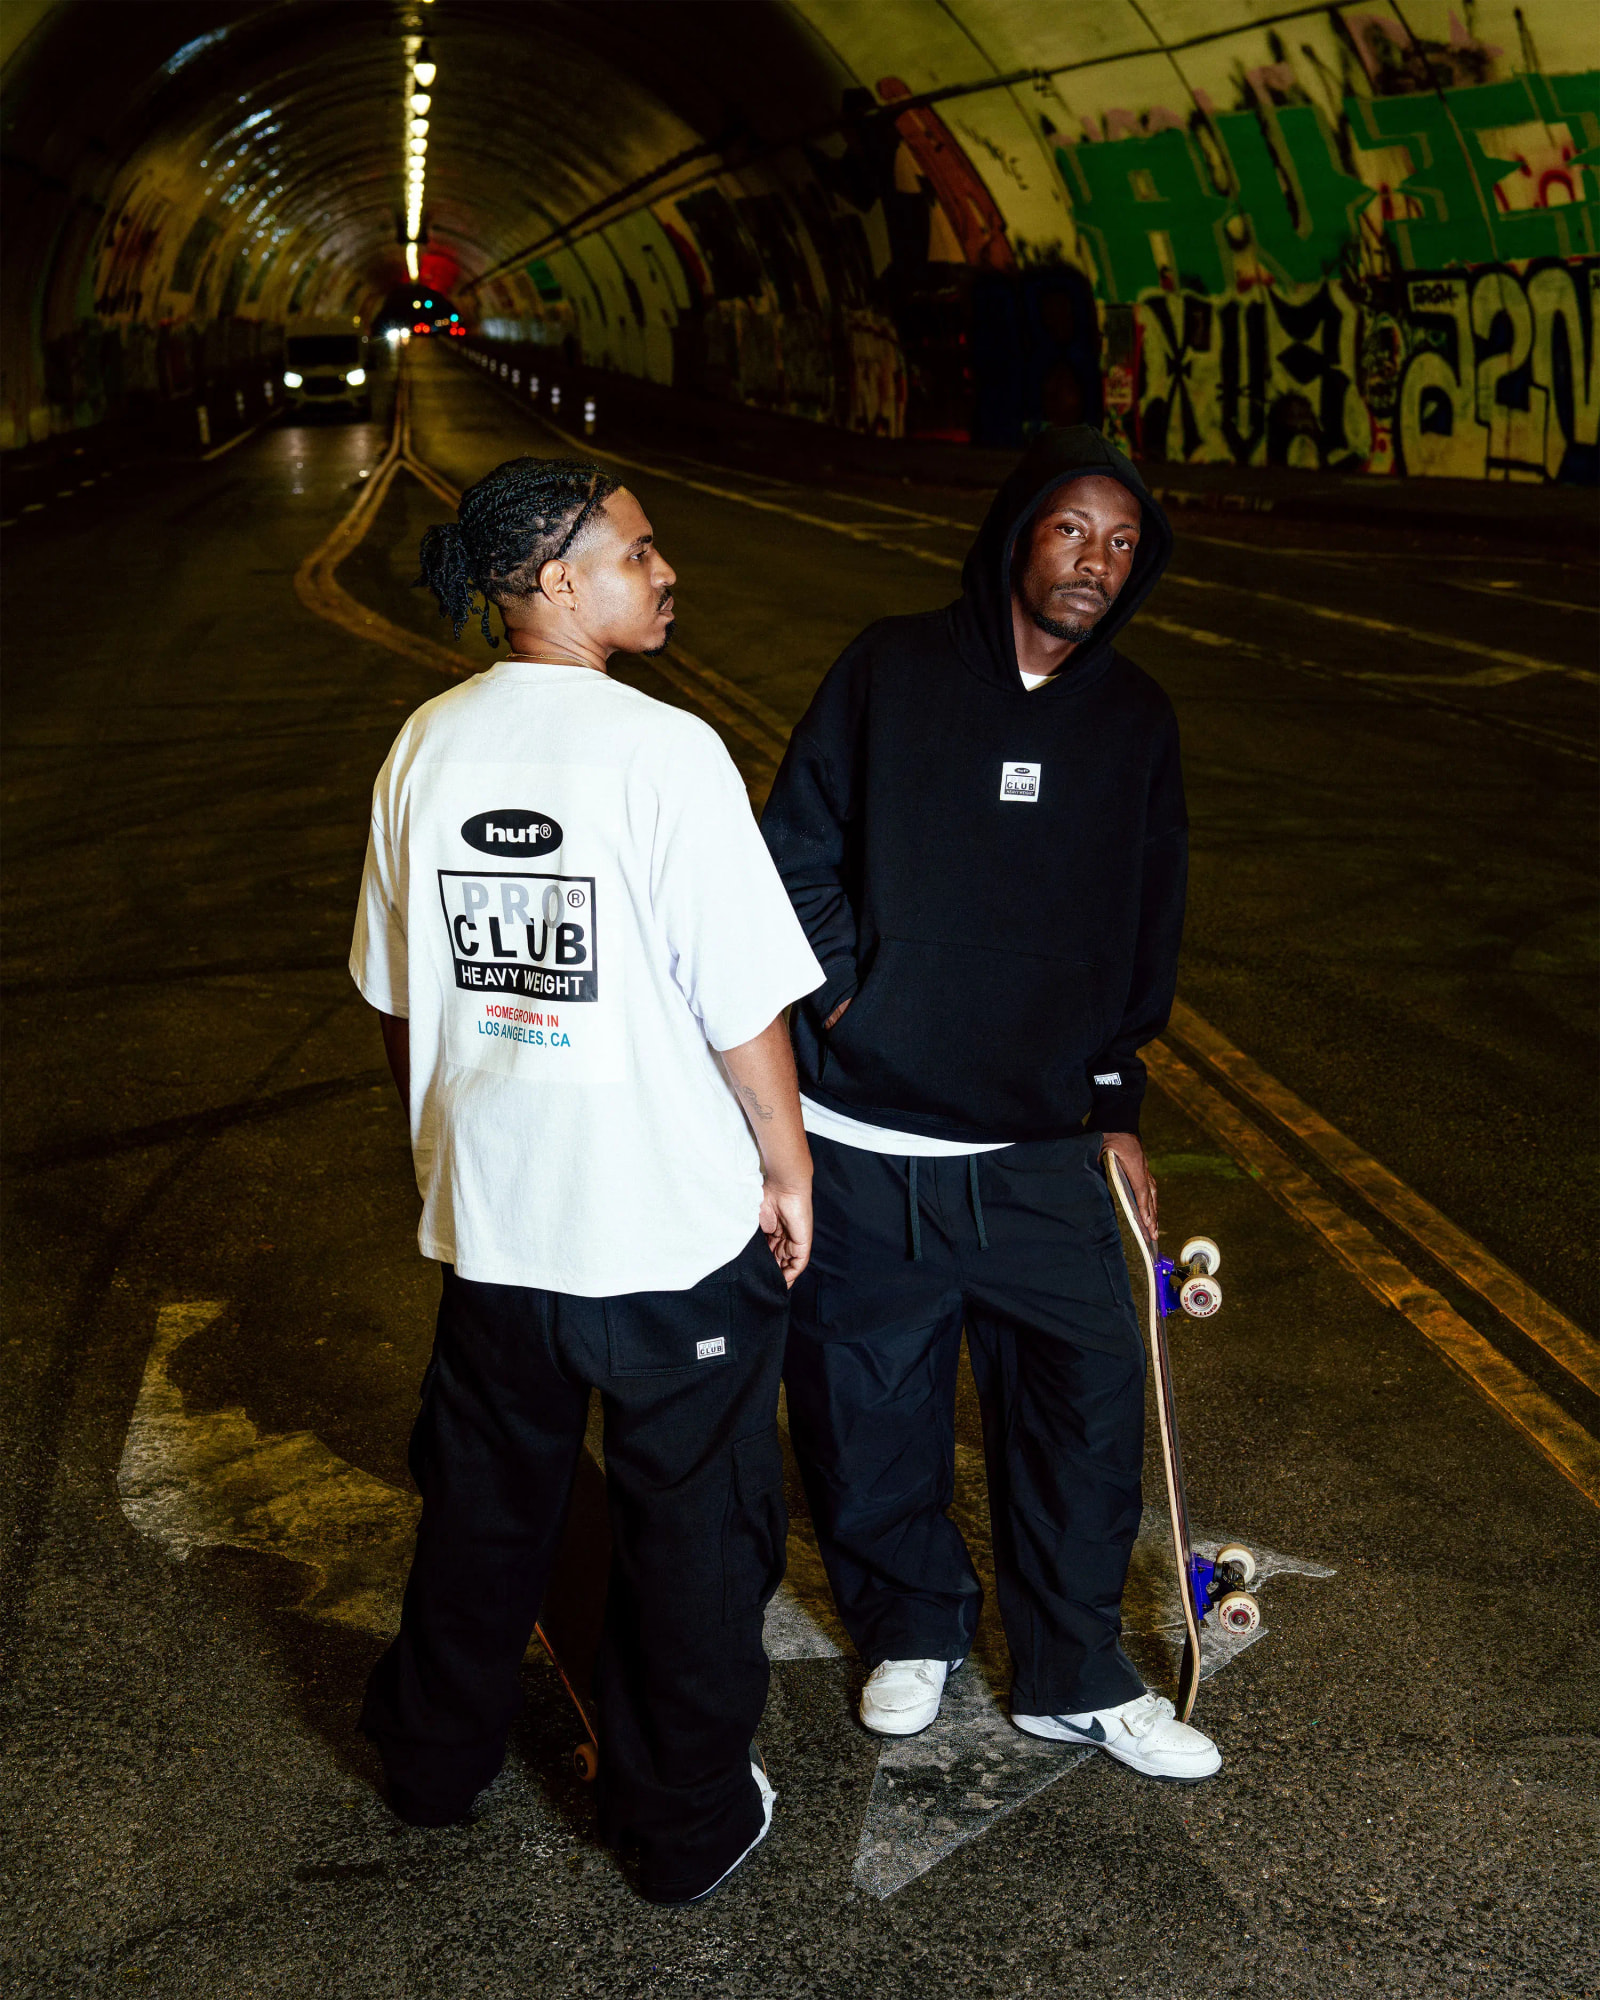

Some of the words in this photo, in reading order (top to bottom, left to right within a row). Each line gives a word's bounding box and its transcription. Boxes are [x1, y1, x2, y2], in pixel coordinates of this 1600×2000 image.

[1007, 781, 1034, 790] CLUB
[453, 914, 587, 966] CLUB
[461, 964, 520, 988] HEAVY
[523, 969, 584, 996] WEIGHT
[486, 1004, 543, 1026] HOMEGROWN
[546, 1014, 559, 1027] IN
[478, 1020, 500, 1036] LOS
[500, 1023, 548, 1048] ANGELES,
[550, 1032, 571, 1047] CA
[700, 1346, 721, 1354] CLUB
